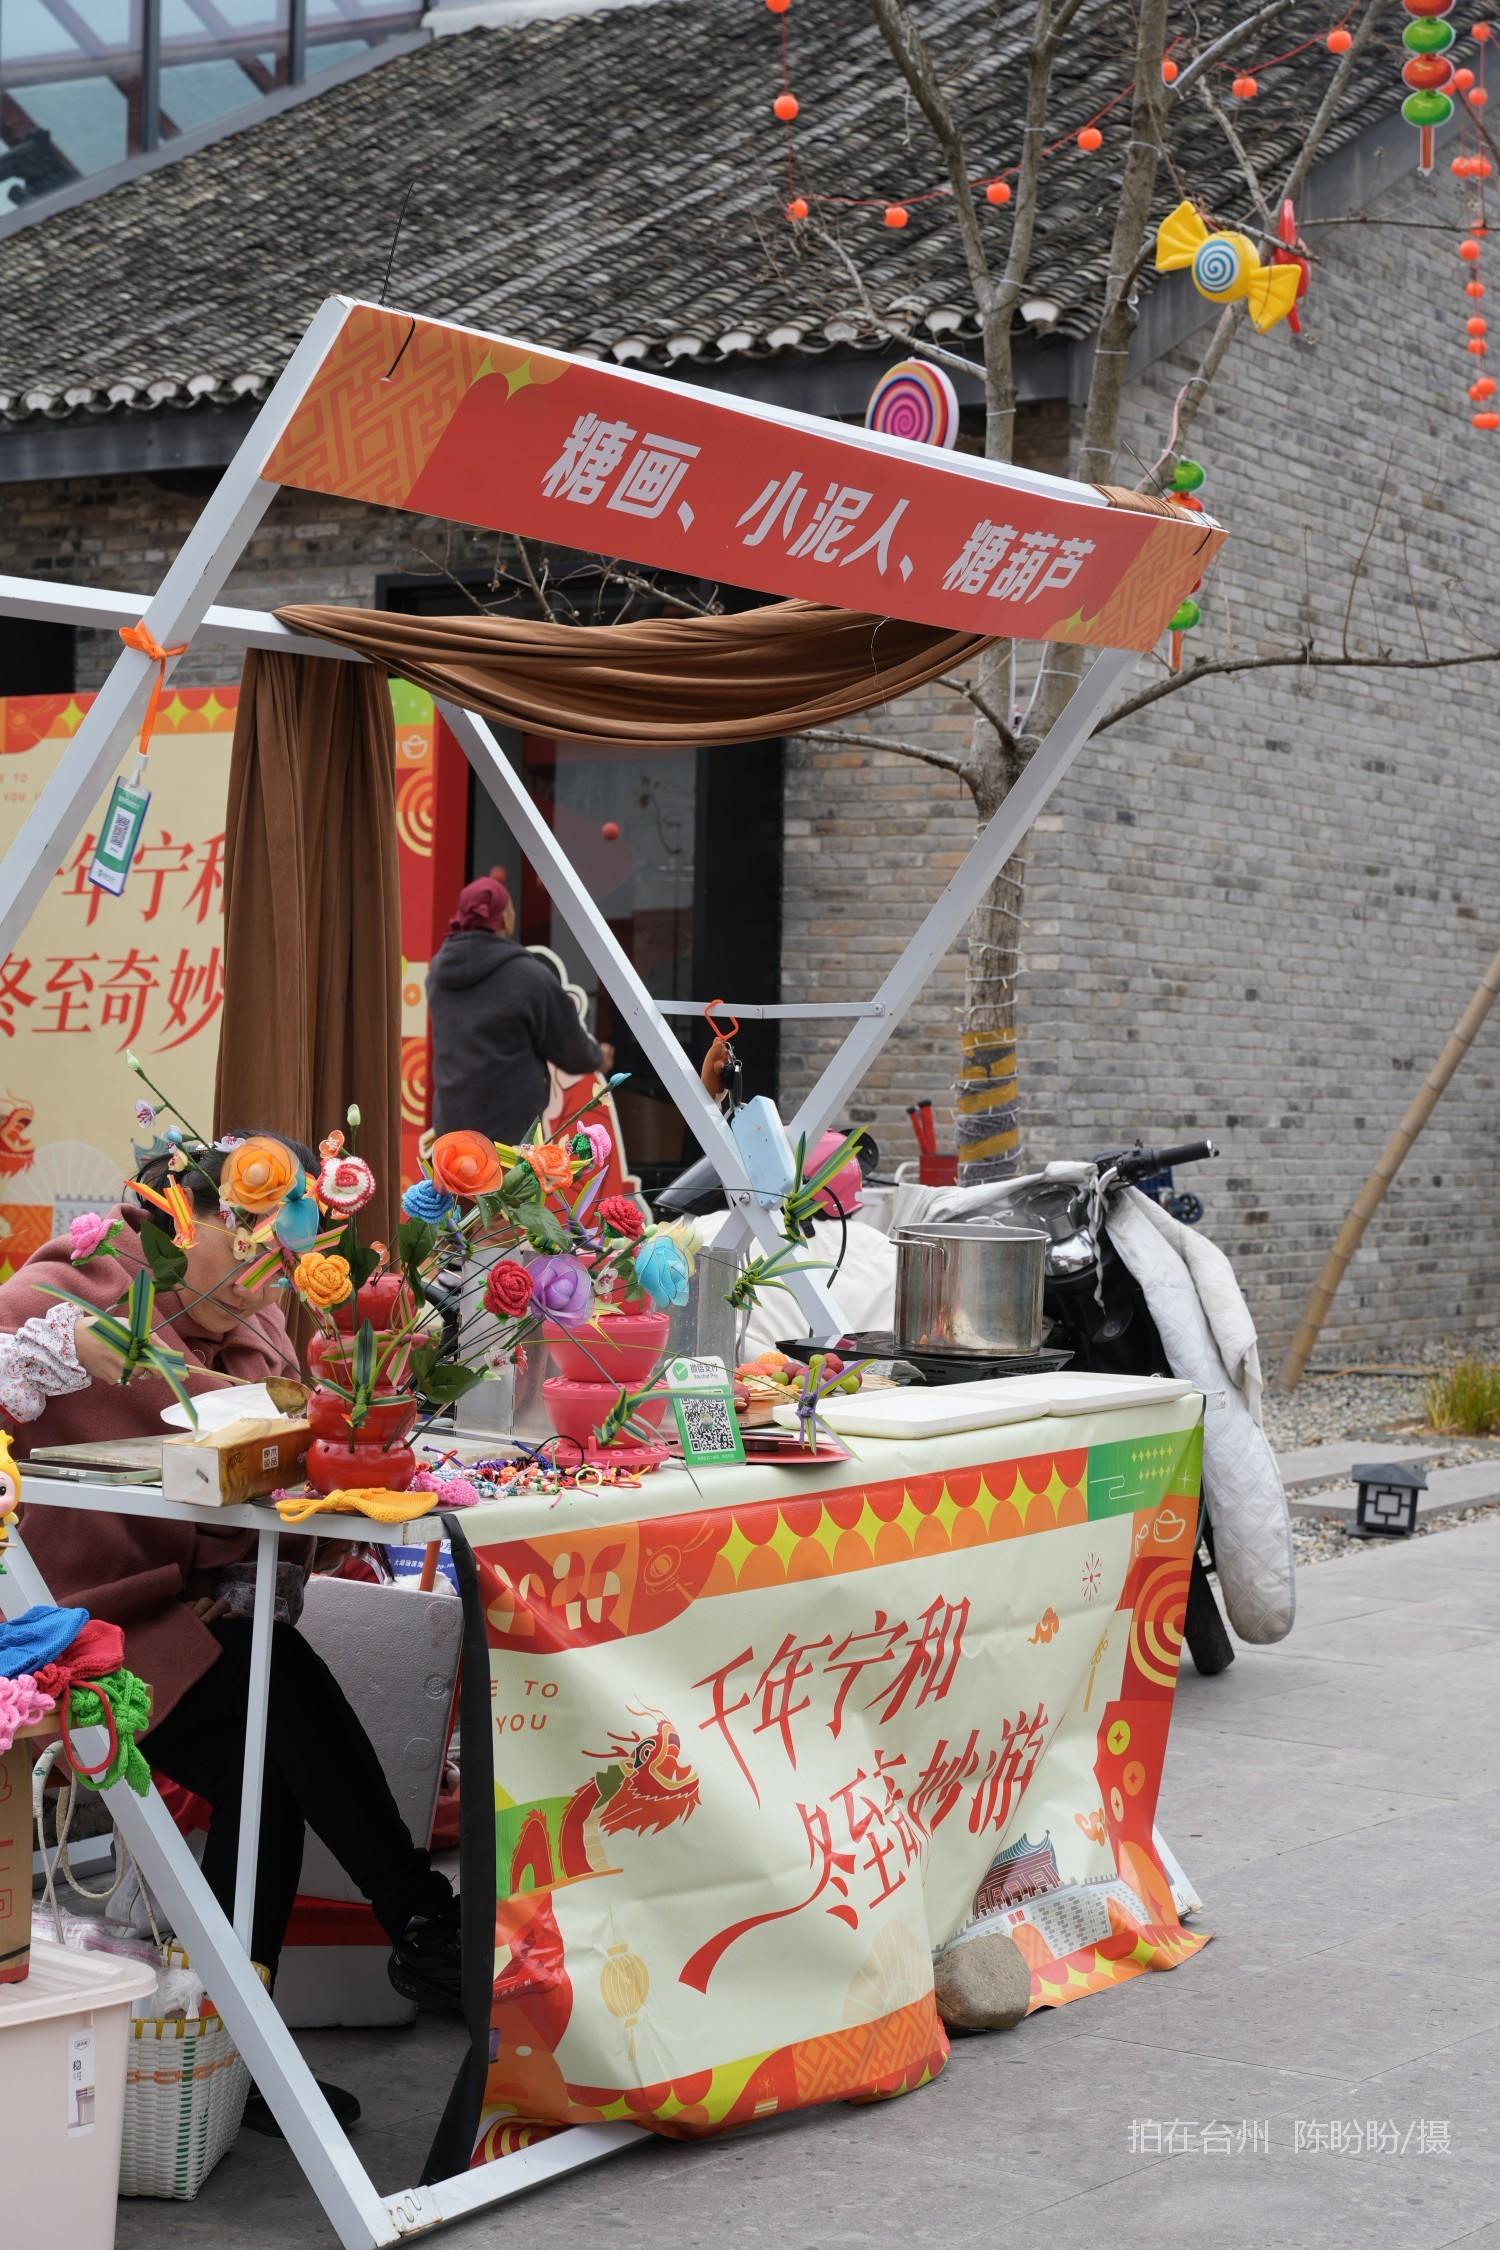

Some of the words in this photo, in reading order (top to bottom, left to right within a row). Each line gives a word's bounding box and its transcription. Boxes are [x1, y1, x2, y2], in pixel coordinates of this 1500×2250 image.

[540, 411, 702, 533] 糖画、
[734, 470, 914, 583] 小泥人、
[941, 518, 1096, 605] 糖葫芦
[495, 1714, 547, 1735] YOU
[524, 1680, 559, 1698] TO
[691, 1594, 971, 1809] 千年宁和
